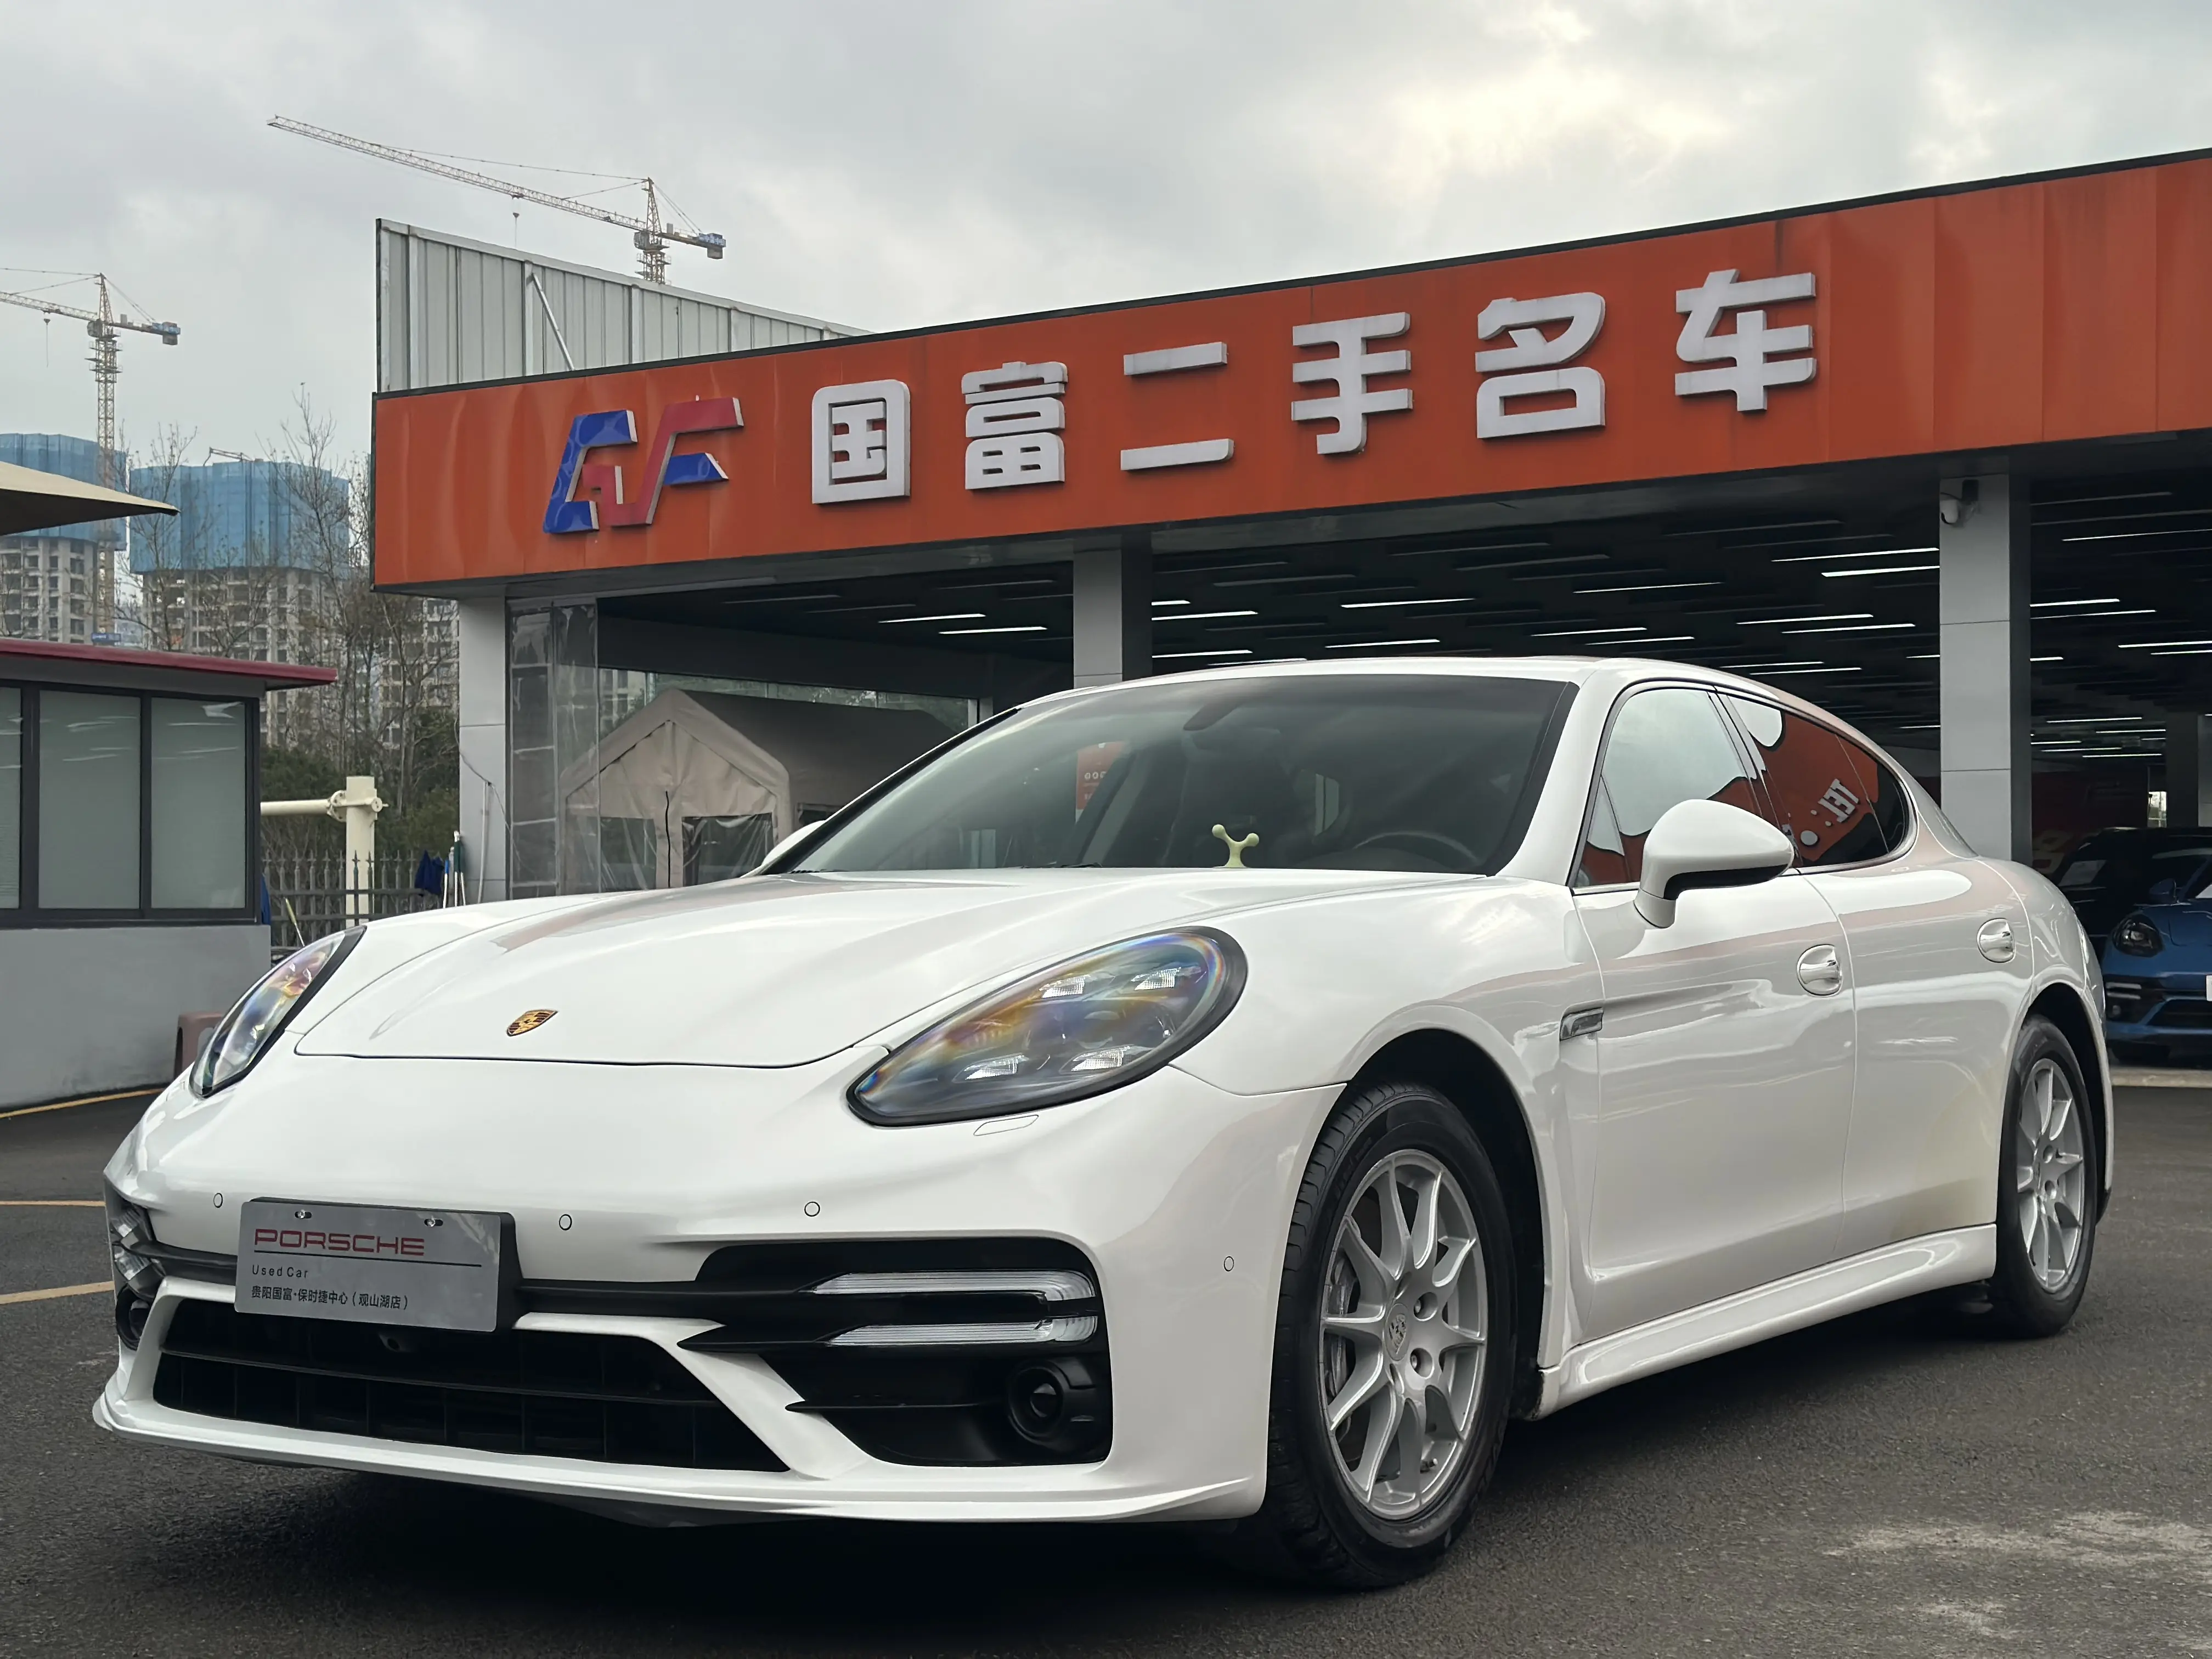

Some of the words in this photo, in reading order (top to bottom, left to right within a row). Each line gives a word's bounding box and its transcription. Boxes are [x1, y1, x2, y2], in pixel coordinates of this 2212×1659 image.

[811, 268, 1818, 504] 国富二手名车
[254, 1228, 425, 1256] PORSCHE
[252, 1264, 283, 1277] Used
[286, 1266, 309, 1279] Car
